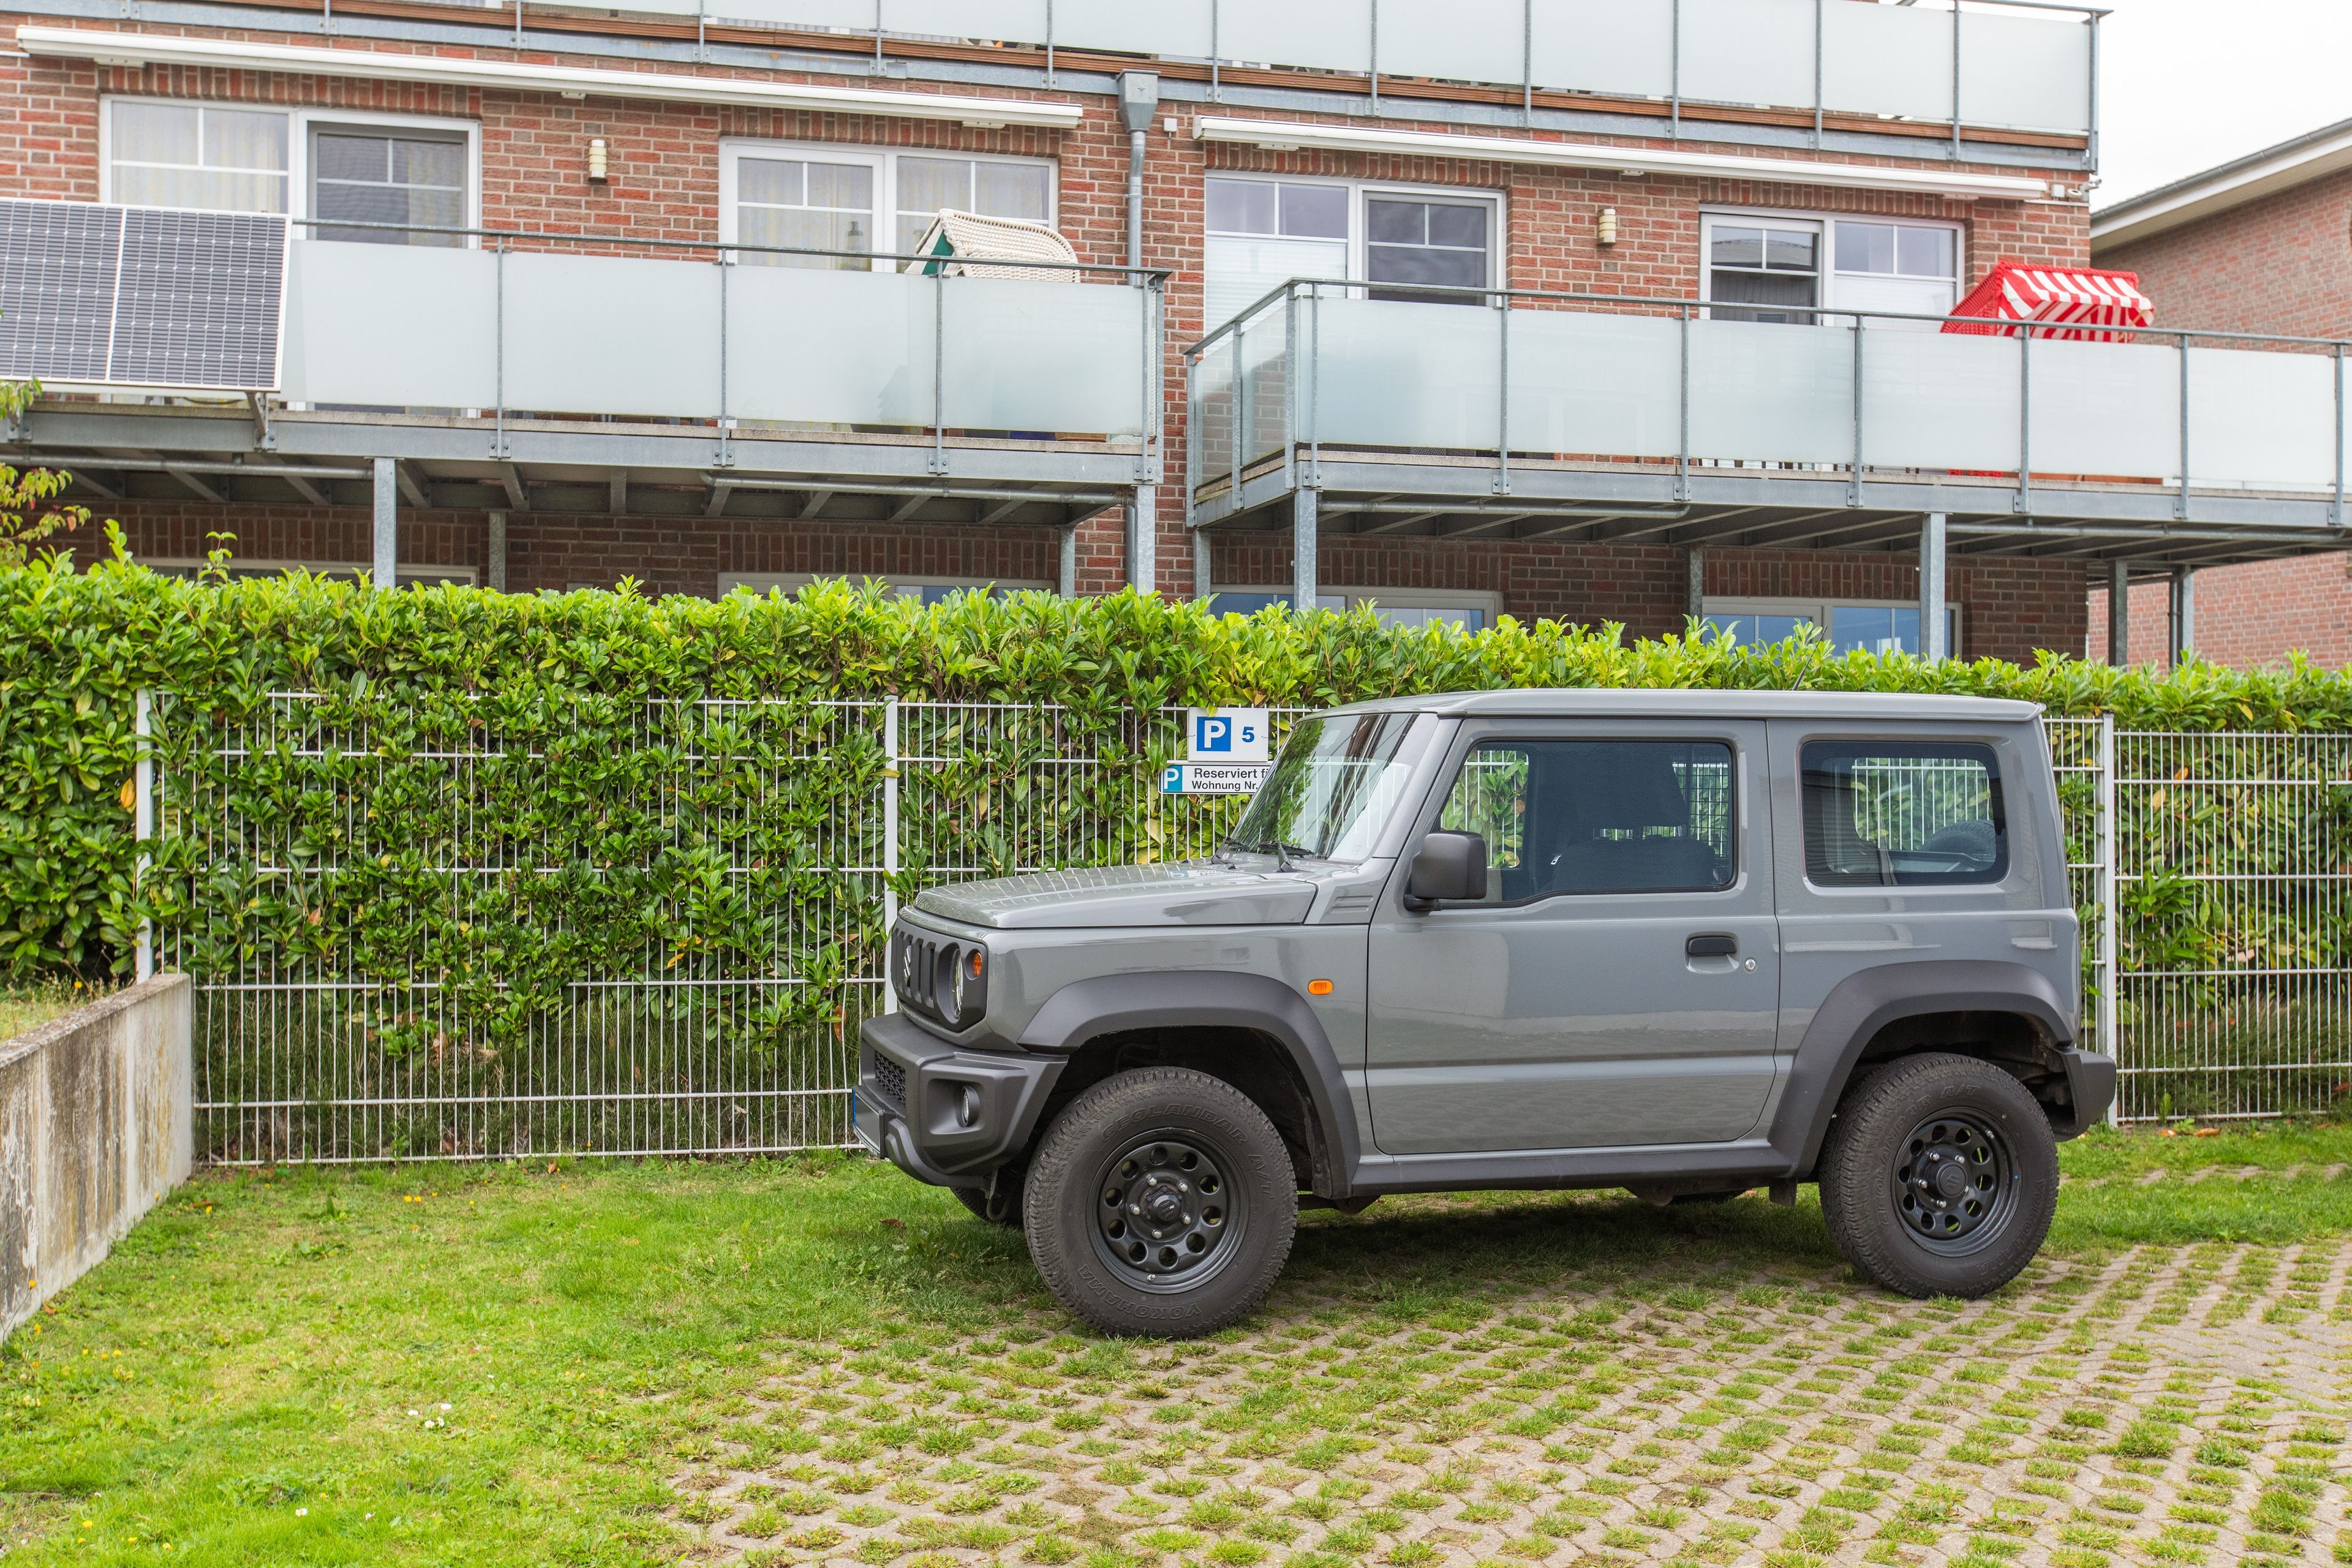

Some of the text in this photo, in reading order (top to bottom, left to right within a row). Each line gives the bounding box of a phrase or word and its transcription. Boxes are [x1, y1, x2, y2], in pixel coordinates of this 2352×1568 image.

[1204, 720, 1255, 748] P 5
[1164, 768, 1179, 790] P
[1194, 767, 1257, 778] Reserviert
[1191, 780, 1258, 791] Wohnung Nr.
[1102, 1104, 1274, 1199] GEOLANDAR A/T
[1077, 1264, 1202, 1320] YOKOHAMA
